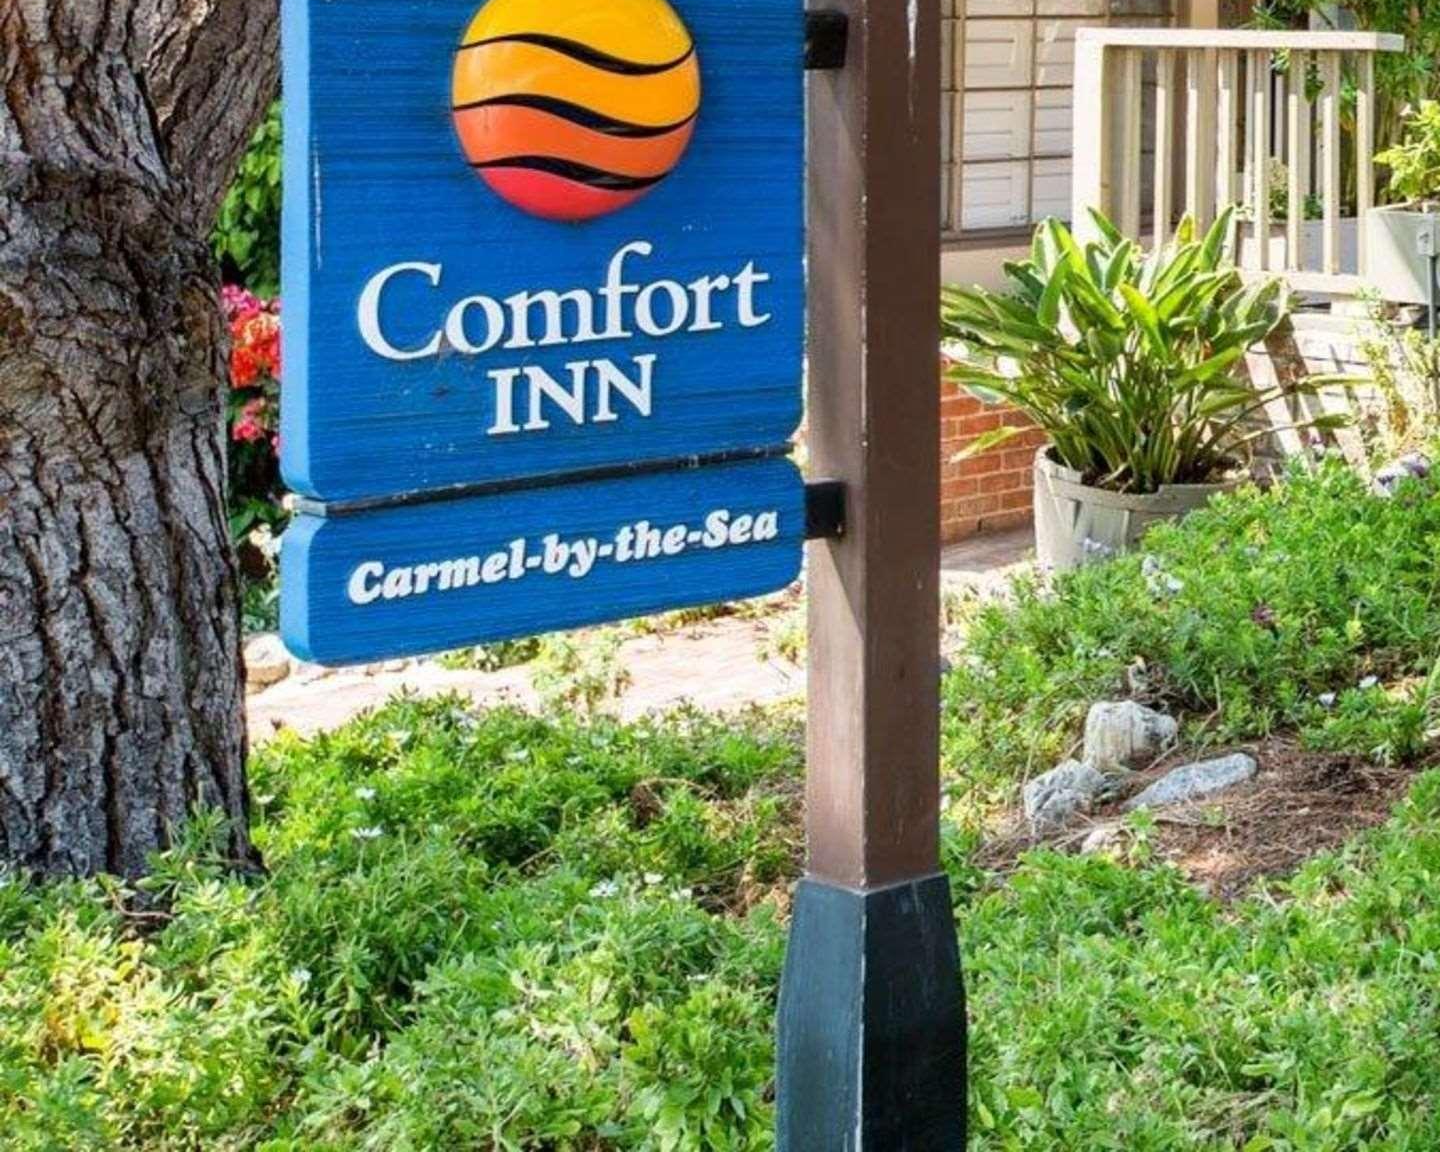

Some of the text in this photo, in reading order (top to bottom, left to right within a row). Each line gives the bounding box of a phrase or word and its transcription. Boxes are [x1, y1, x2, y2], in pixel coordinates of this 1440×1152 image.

[357, 240, 771, 360] Comfort
[486, 353, 657, 435] INN
[347, 508, 779, 605] Carmel-by-the-Sea
